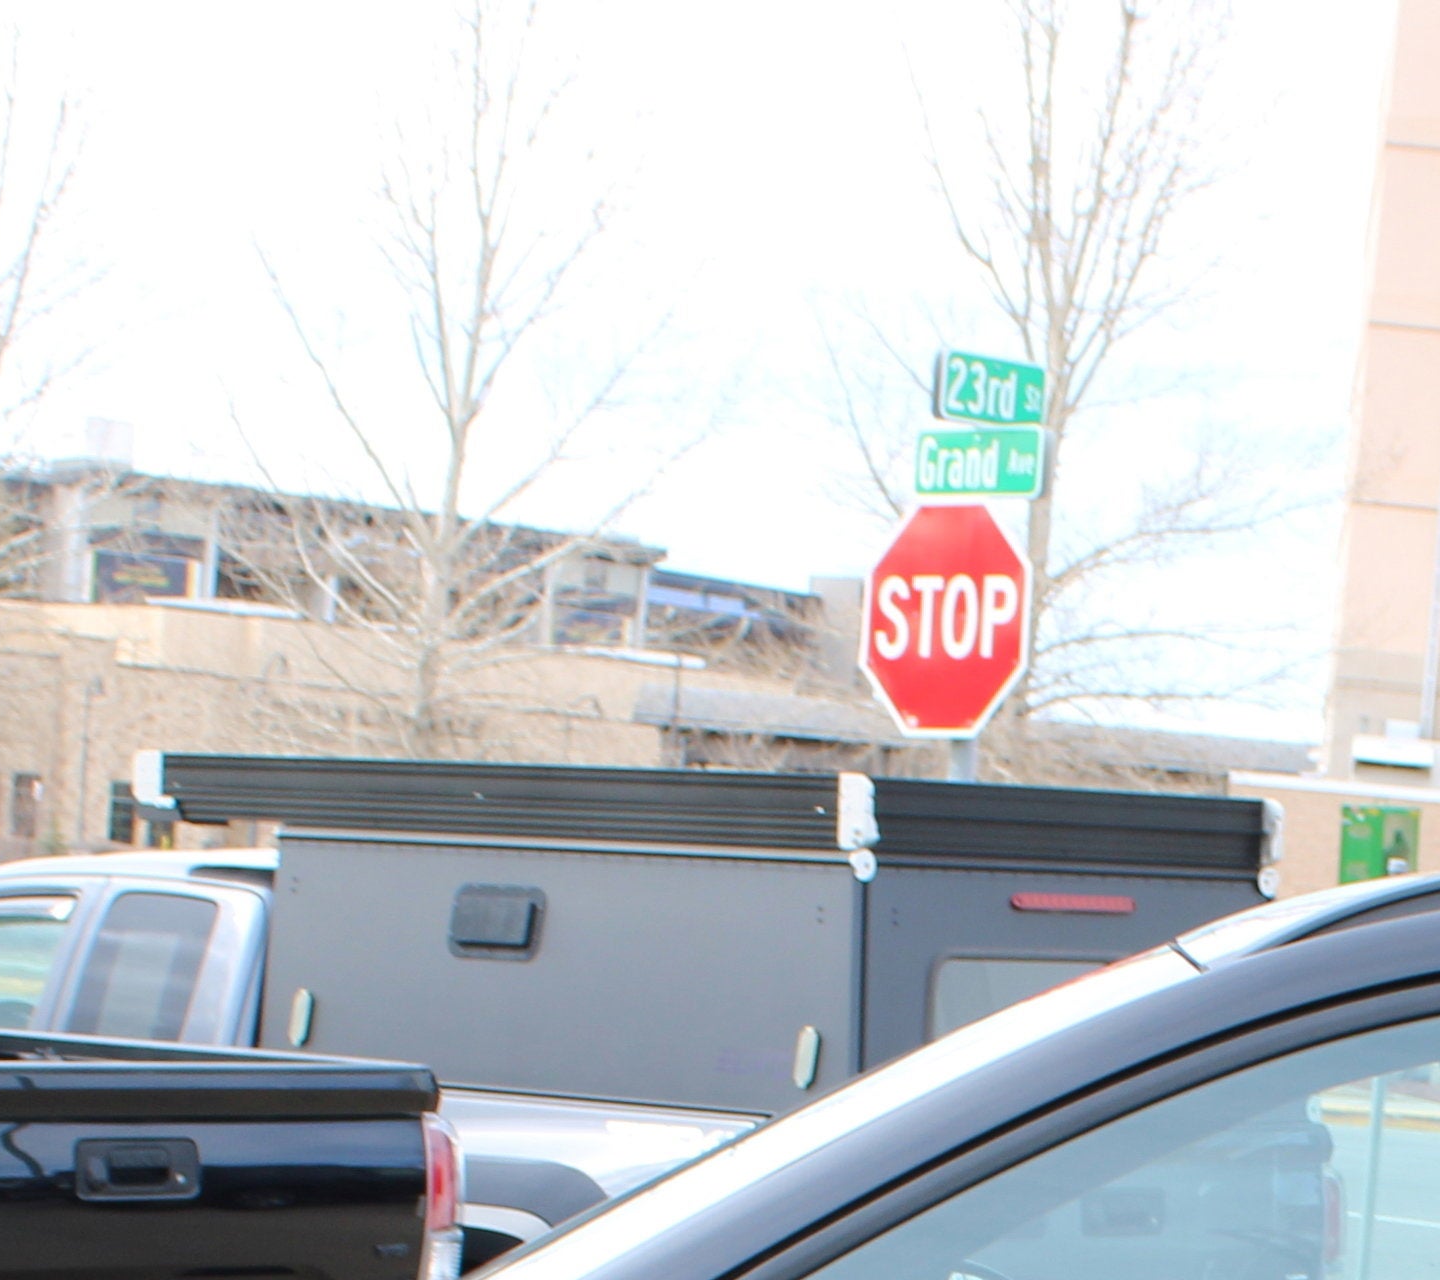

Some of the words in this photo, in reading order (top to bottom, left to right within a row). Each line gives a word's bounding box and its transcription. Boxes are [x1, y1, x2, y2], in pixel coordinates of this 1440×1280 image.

[945, 356, 1018, 420] 23rd
[918, 435, 1000, 491] Grand
[1006, 447, 1035, 476] Ave
[874, 573, 1018, 661] STOP
